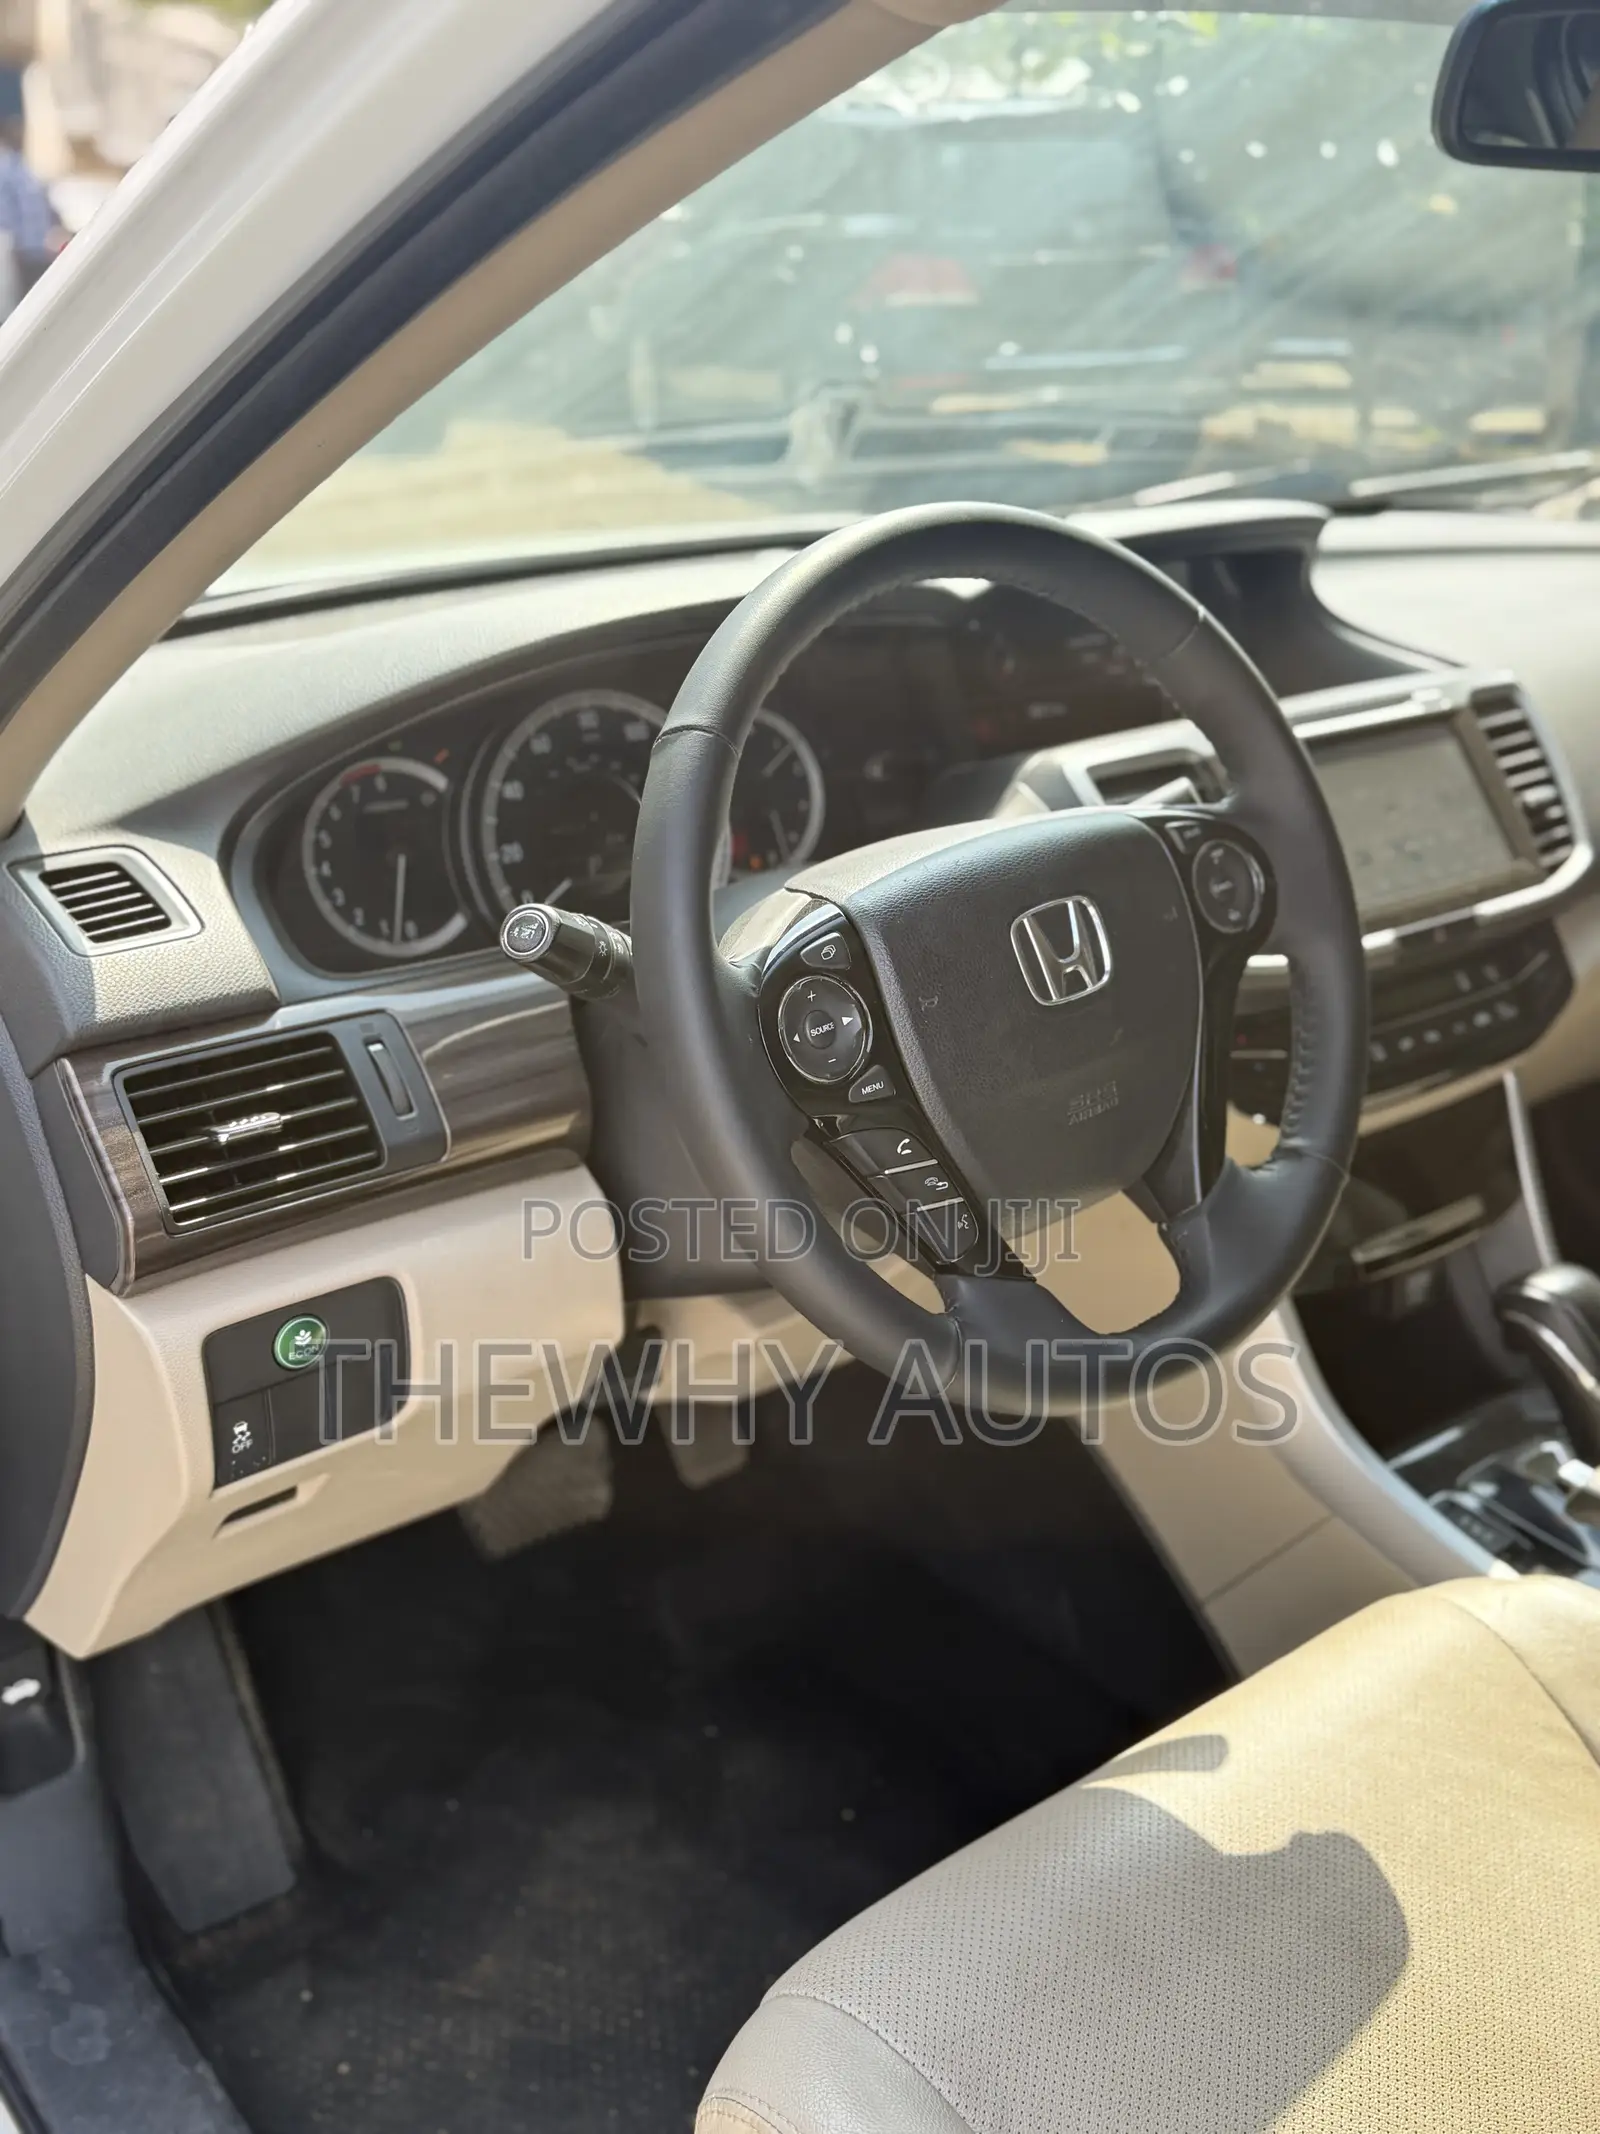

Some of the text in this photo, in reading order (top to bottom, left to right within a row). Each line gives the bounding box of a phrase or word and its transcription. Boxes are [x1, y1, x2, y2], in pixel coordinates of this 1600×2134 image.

[810, 1021, 835, 1037] SOURCE
[861, 1081, 884, 1095] MENU
[288, 1344, 320, 1361] ECON
[231, 1438, 253, 1454] OFF
